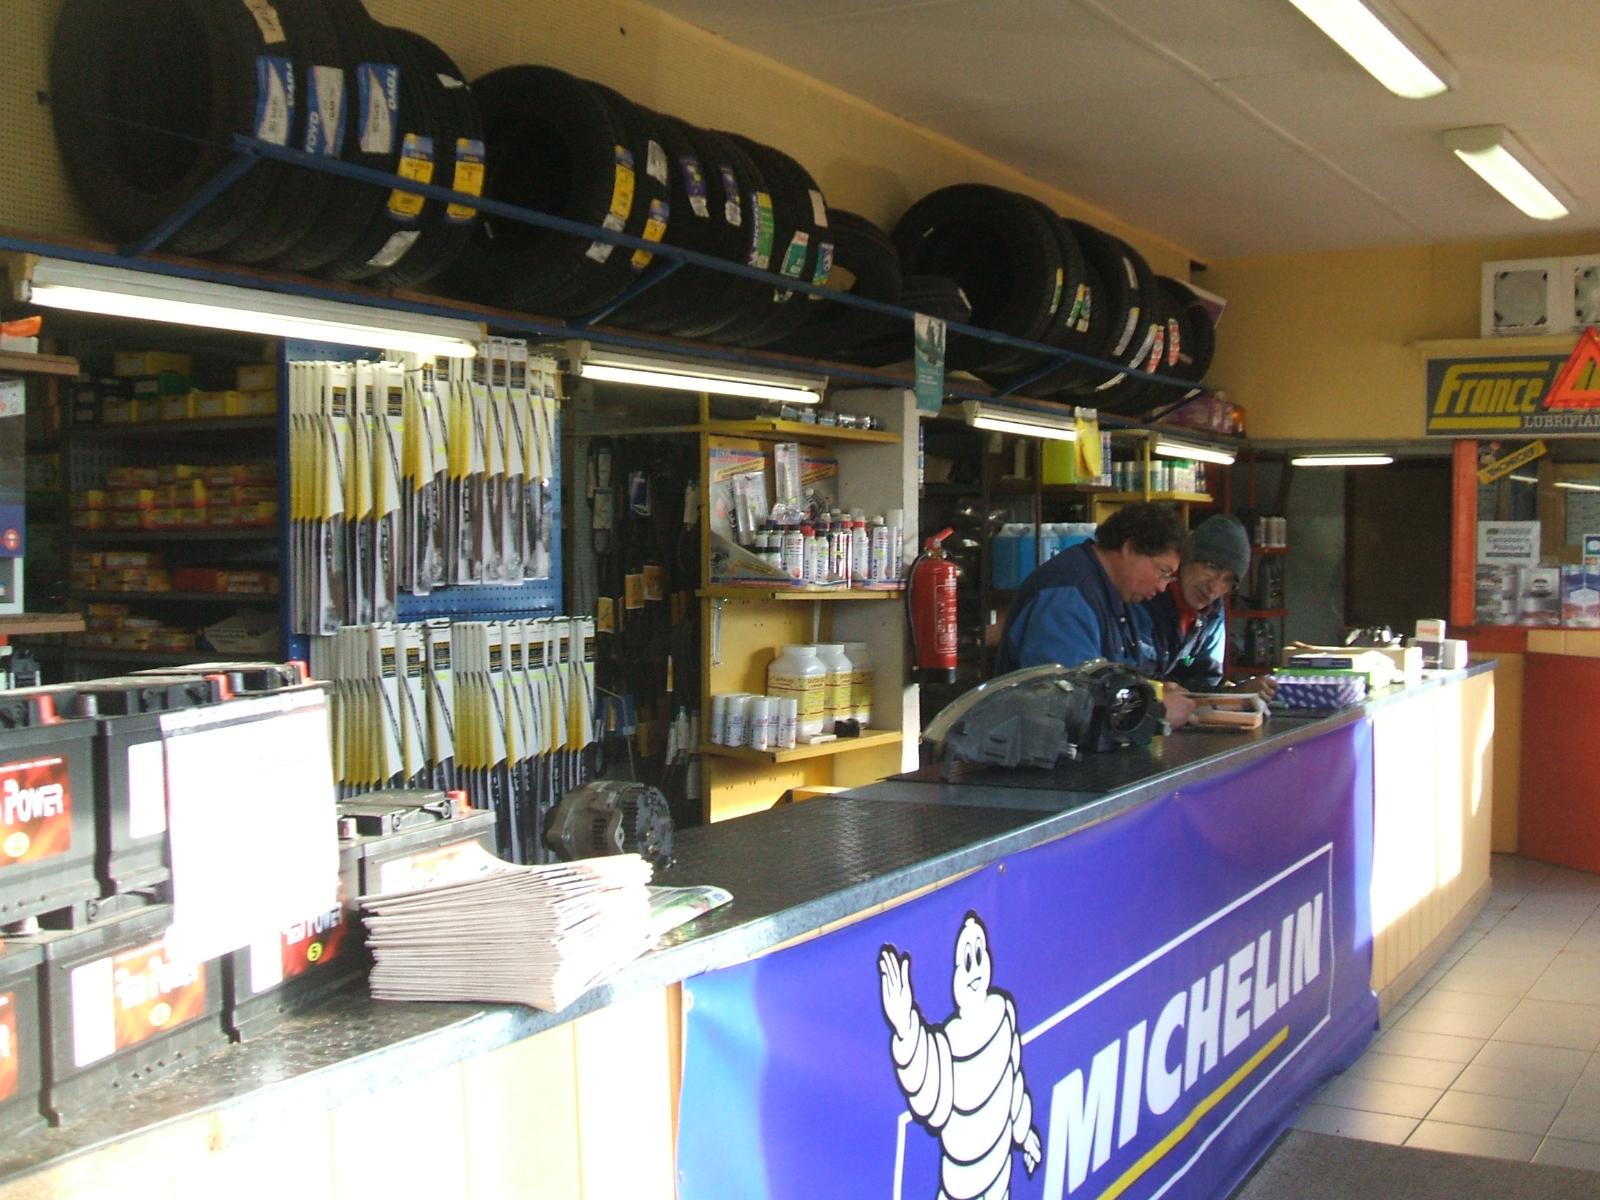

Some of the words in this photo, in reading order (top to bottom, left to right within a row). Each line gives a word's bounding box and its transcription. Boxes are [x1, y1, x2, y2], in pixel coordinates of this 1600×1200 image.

[387, 68, 399, 111] TOYO
[1433, 361, 1550, 414] France
[3, 778, 65, 825] POWER
[1043, 892, 1323, 1200] MICHELIN
